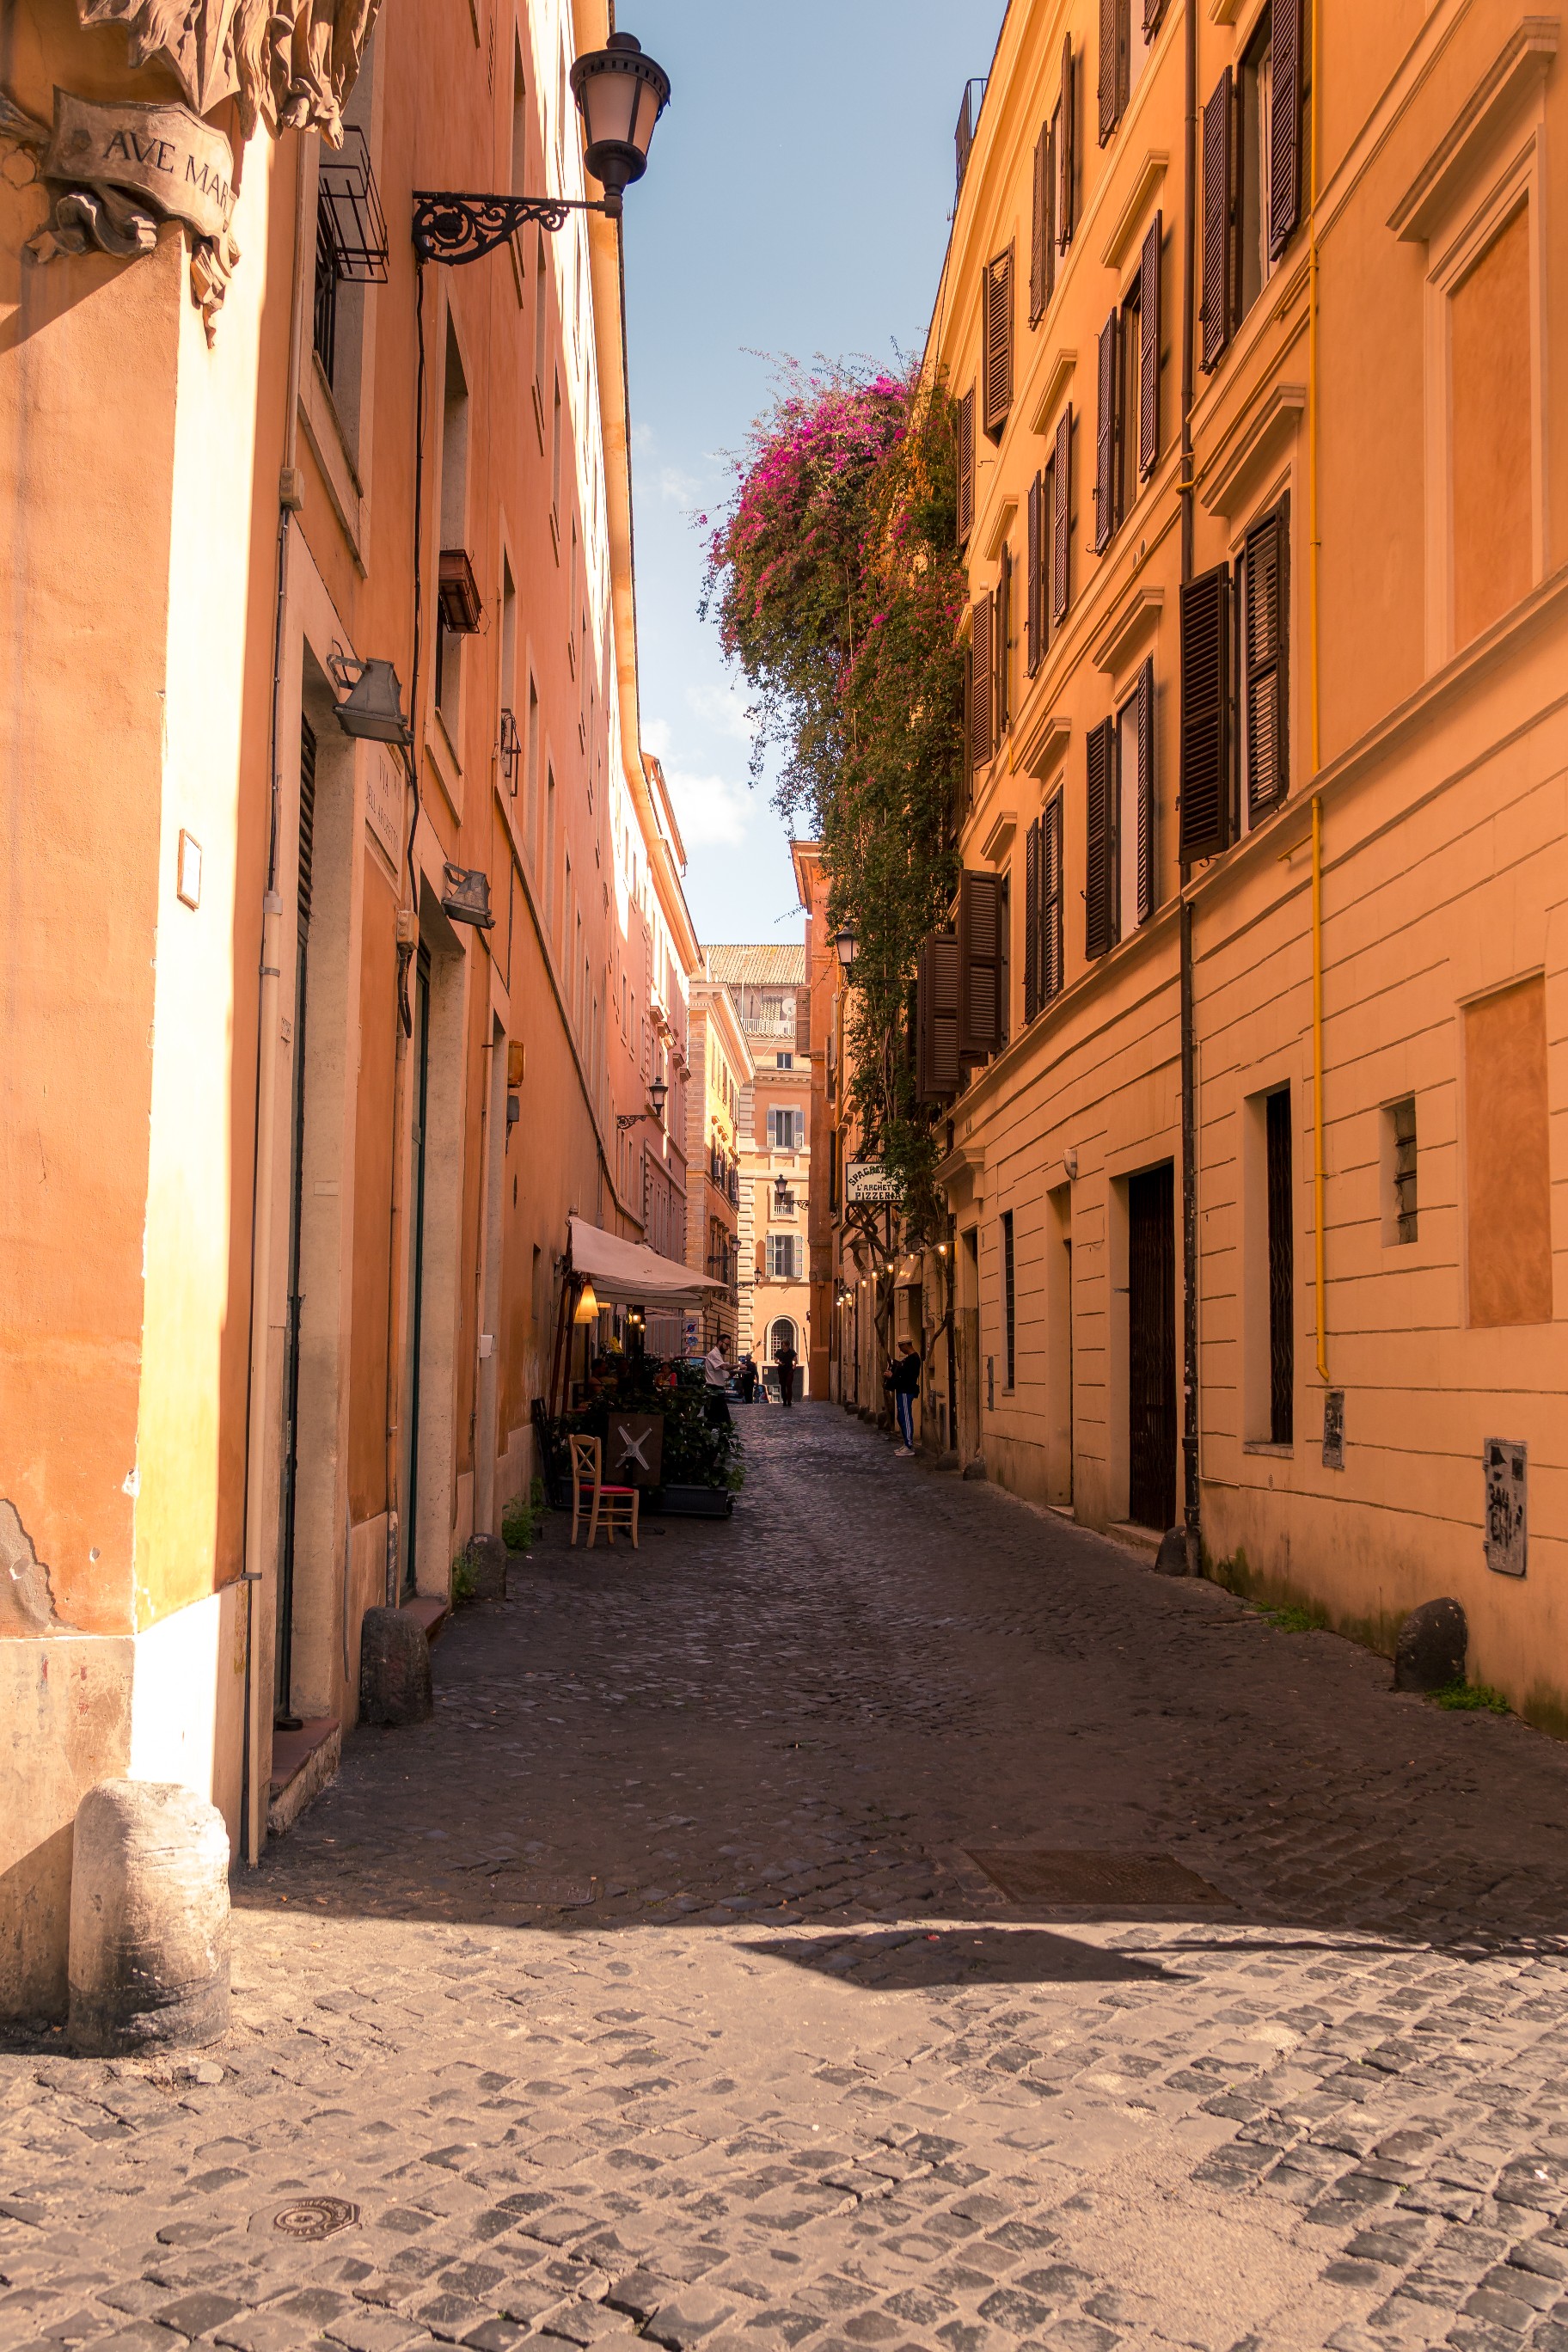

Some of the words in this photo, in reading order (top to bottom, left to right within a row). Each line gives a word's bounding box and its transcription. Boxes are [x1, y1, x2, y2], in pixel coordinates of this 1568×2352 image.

[103, 131, 175, 174] AVE
[185, 155, 229, 214] MAR
[379, 755, 389, 798] VIA
